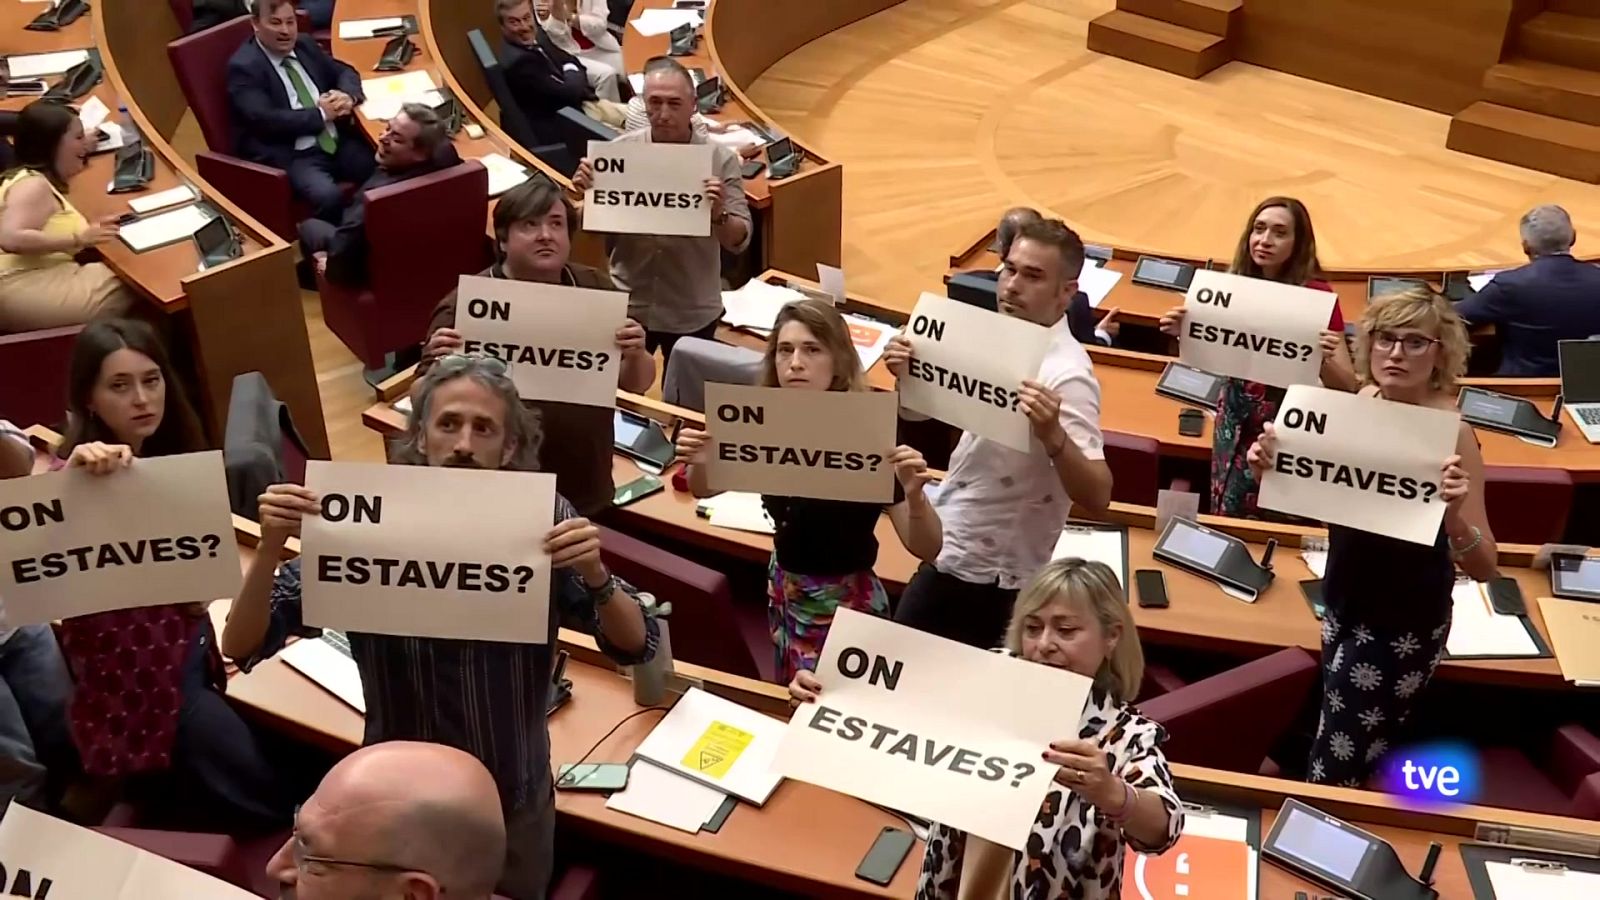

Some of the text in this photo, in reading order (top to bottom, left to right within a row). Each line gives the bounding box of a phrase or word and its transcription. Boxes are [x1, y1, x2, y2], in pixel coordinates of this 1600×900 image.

[594, 157, 625, 174] ON
[594, 189, 703, 209] ESTAVES?
[468, 299, 511, 321] ON
[1196, 288, 1232, 309] ON
[912, 315, 946, 341] ON
[1189, 321, 1313, 362] ESTAVES?
[465, 340, 610, 372] ESTAVES?
[909, 356, 1021, 412] ESTAVES?
[718, 404, 764, 425] ON
[1283, 408, 1328, 435] ON
[719, 443, 883, 472] ESTAVES?
[1275, 451, 1438, 504] ESTAVES?
[0, 498, 65, 531] ON
[321, 493, 382, 524] ON
[12, 534, 221, 584] ESTAVES?
[318, 554, 534, 594] ESTAVES?
[836, 646, 904, 691] ON
[808, 705, 1036, 788] ESTAVES?
